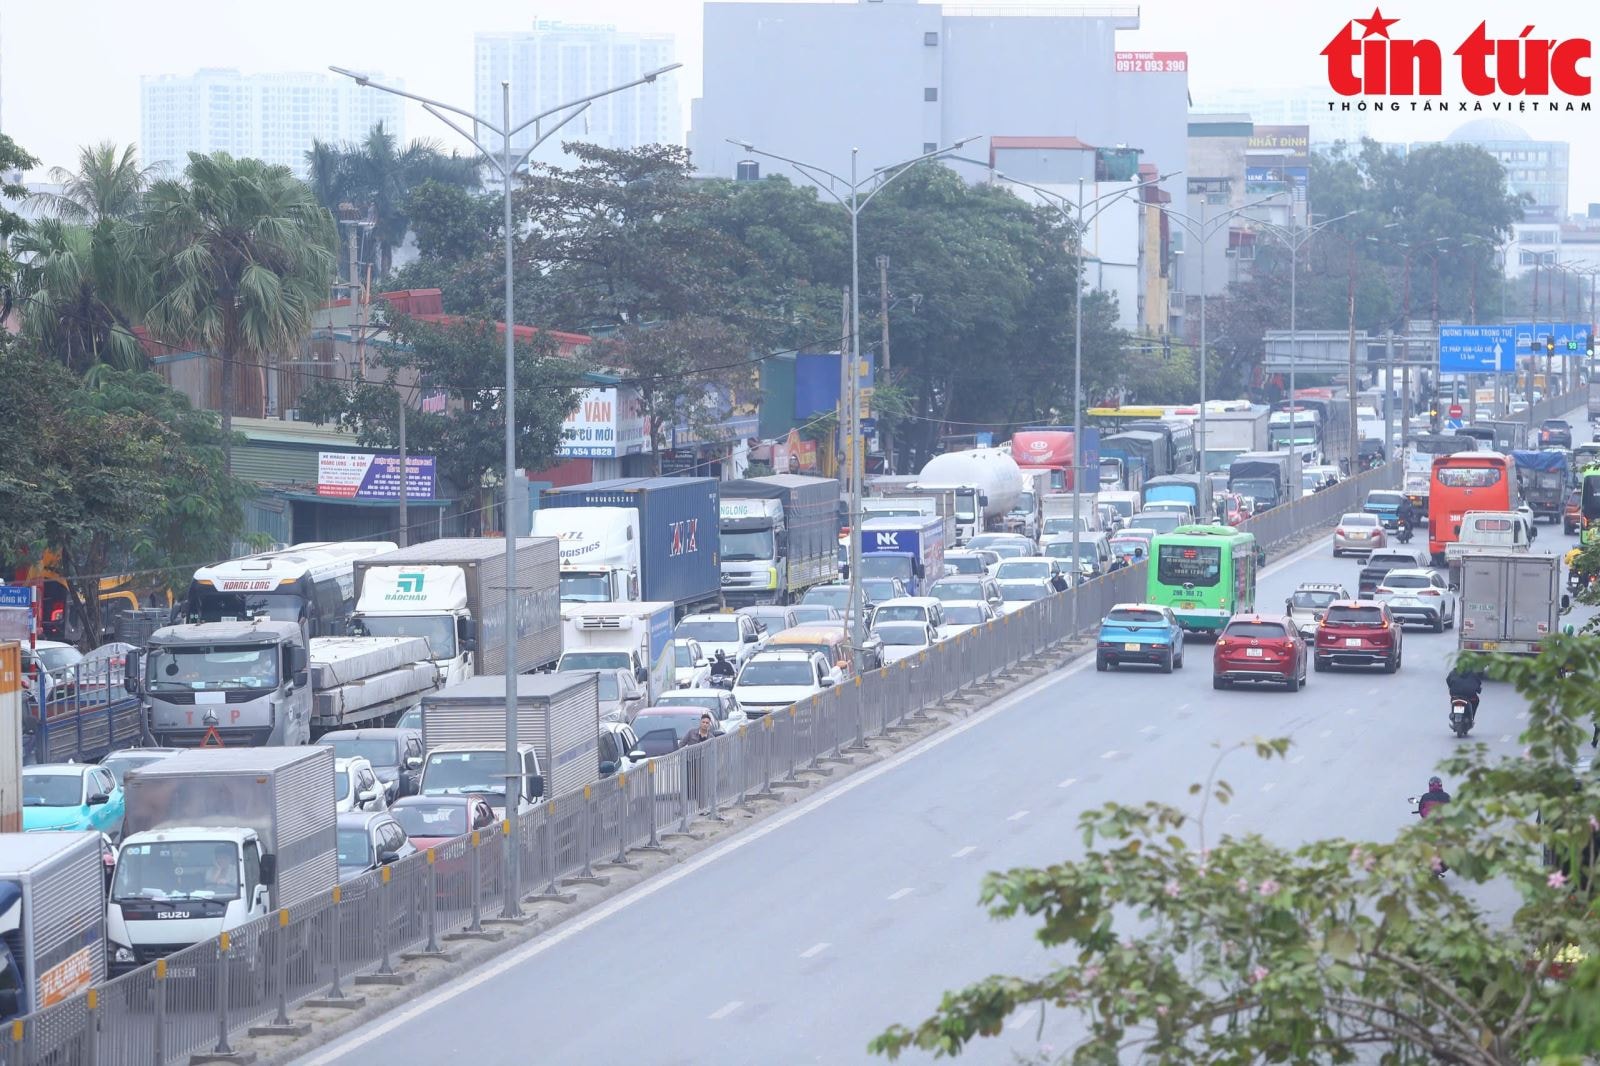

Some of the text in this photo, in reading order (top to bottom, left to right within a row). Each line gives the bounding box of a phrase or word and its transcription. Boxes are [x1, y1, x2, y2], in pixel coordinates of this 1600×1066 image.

[1117, 60, 1185, 72] 0912 093 390
[585, 398, 611, 422] VÂN
[595, 426, 614, 441] MỚI
[572, 448, 589, 456] 454
[876, 532, 898, 545] NK
[250, 580, 270, 590] LONG
[185, 710, 241, 725] T P
[157, 911, 190, 919] ISUZU
